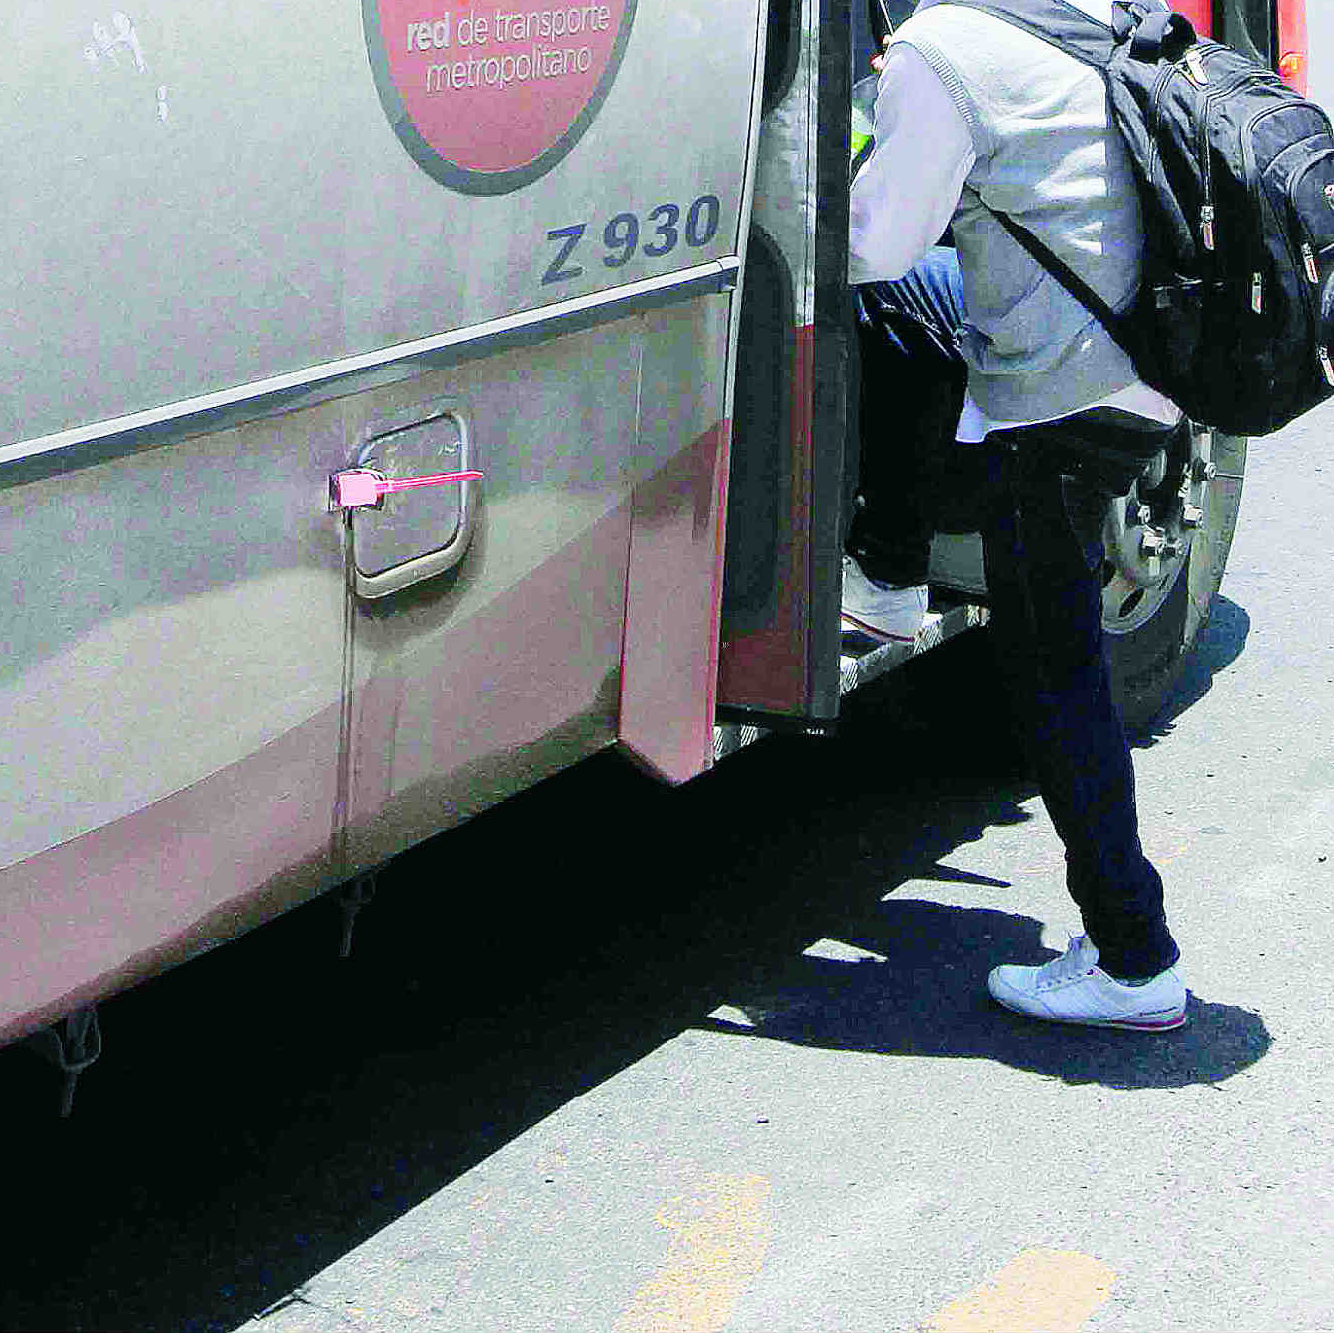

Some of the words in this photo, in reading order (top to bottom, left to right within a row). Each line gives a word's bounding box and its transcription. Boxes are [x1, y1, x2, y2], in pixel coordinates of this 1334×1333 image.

[406, 11, 451, 52] red
[457, 9, 490, 48] de
[493, 2, 612, 44] transporte
[426, 44, 593, 93] metropolitano
[541, 223, 588, 286] Z
[602, 194, 722, 268] 930
